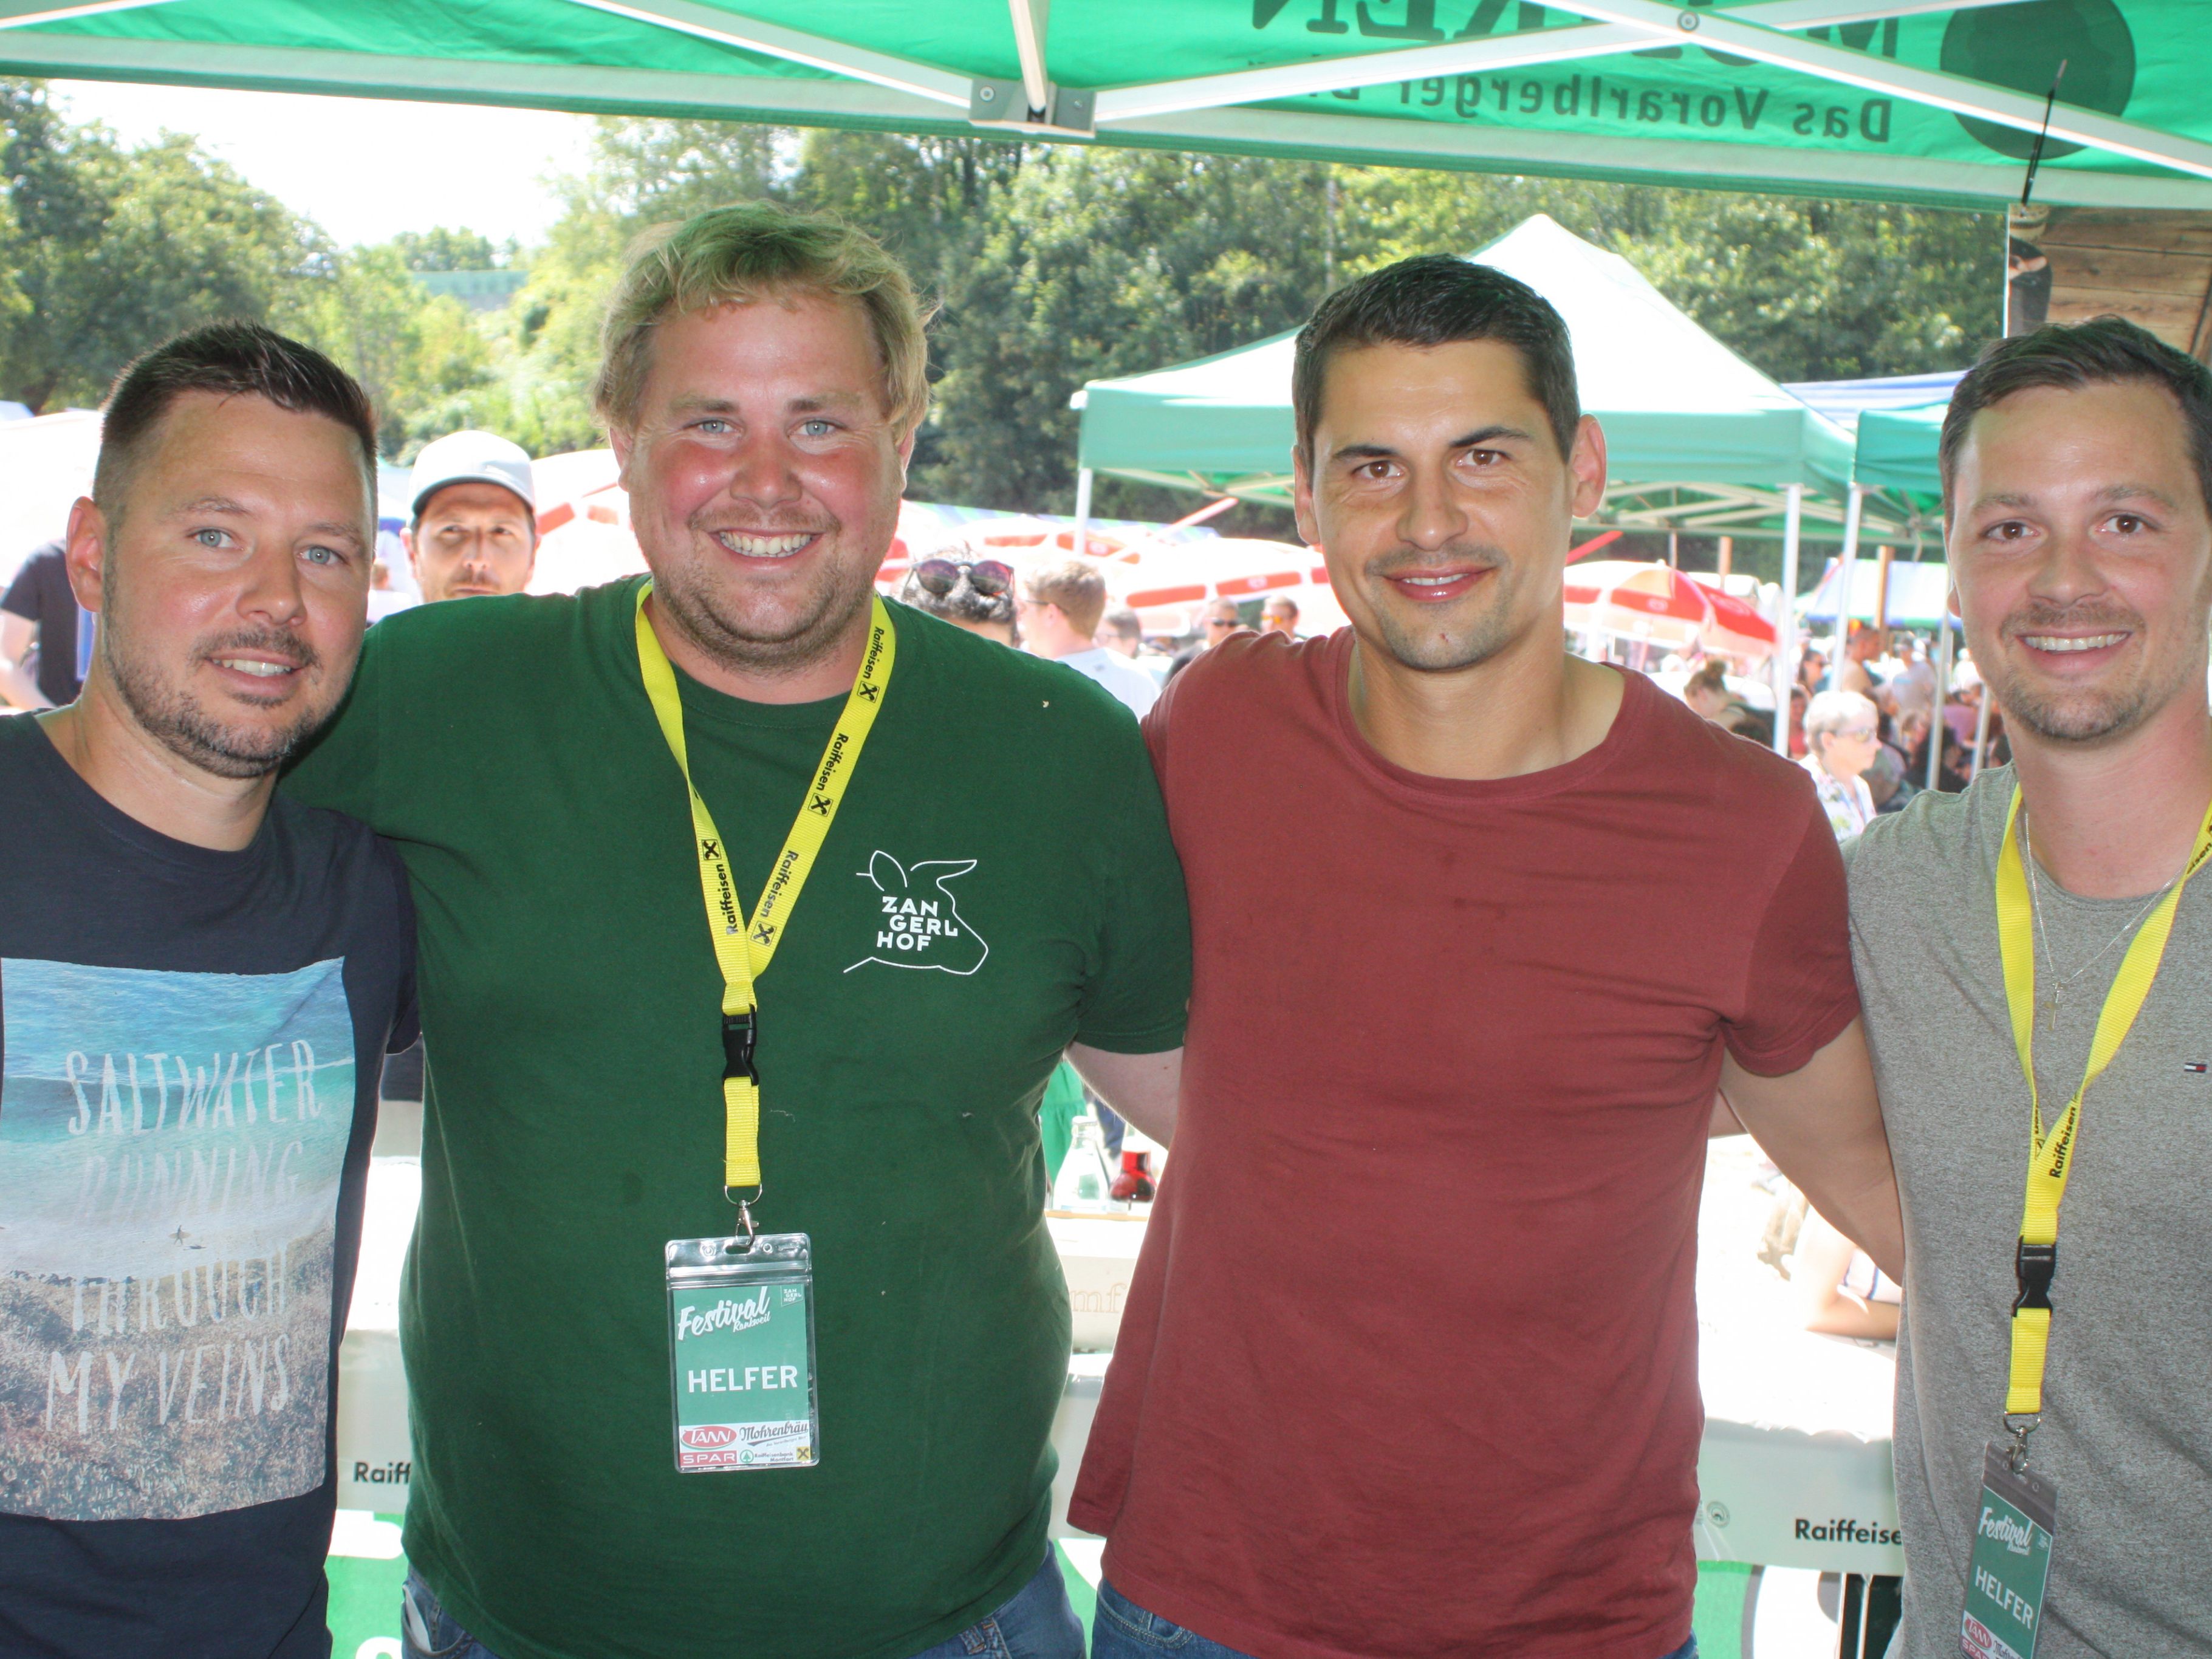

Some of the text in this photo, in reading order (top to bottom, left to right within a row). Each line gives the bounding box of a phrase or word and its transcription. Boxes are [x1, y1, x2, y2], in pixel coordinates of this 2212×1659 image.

[863, 626, 885, 680] Raiffeisen
[817, 733, 849, 792] Raiffeisen
[716, 863, 739, 935] Raiffeisen
[760, 850, 799, 918] Raiffeisen
[882, 895, 938, 917] ZAN
[877, 931, 931, 951] HOF
[889, 914, 958, 937] GERL
[65, 1039, 323, 1135] SALTWATER
[2049, 1107, 2077, 1178] Raiffeisen
[678, 1286, 770, 1341] Festival
[733, 1311, 771, 1333] Rankweil
[46, 1333, 291, 1433] MY VEINS
[688, 1365, 798, 1394] HELFER
[682, 1453, 736, 1465] SPAR
[683, 1428, 731, 1445] TANN
[1978, 1507, 2033, 1547] Festival
[1975, 1565, 2034, 1629] HELFER
